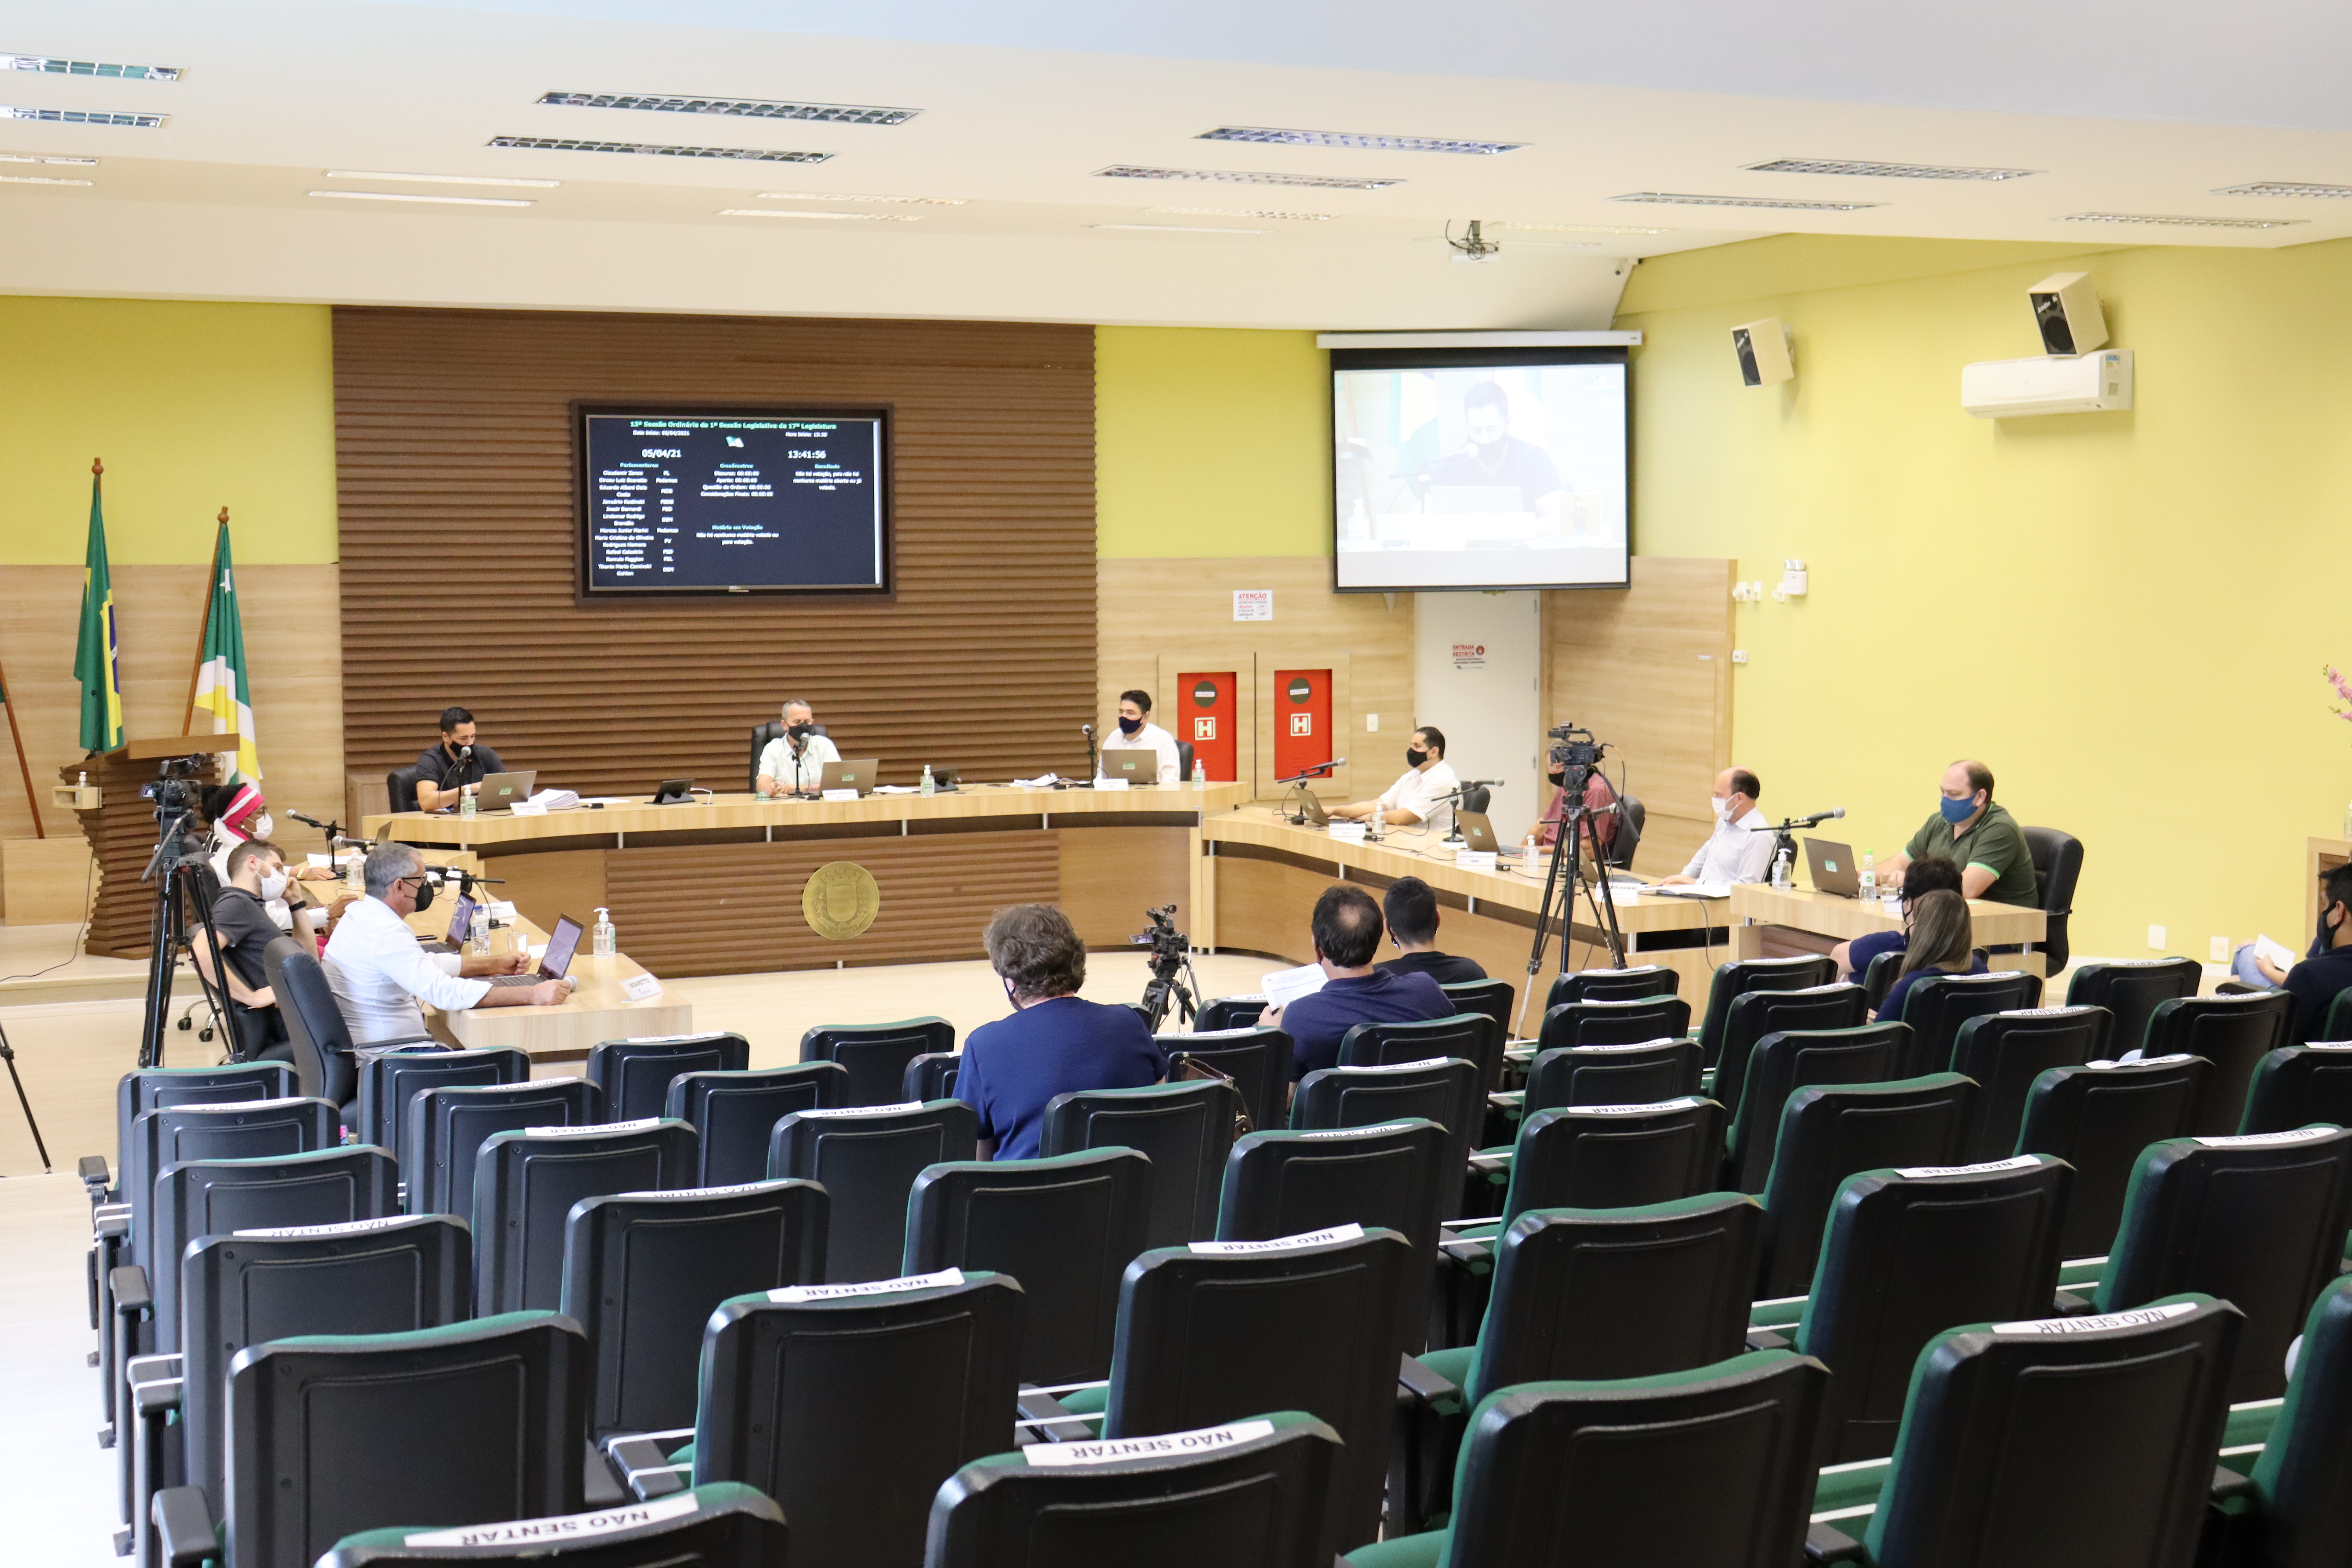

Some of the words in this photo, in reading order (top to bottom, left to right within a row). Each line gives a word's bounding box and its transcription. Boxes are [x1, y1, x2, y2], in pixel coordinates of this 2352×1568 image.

[642, 449, 681, 458] 05/04/21
[788, 450, 826, 459] 13:41:56
[1198, 721, 1212, 736] H
[1294, 717, 1307, 732] H
[272, 1225, 344, 1236] SENTAR
[1222, 1241, 1292, 1251] SENTAR
[1297, 1232, 1334, 1246] NÃO
[804, 1286, 882, 1296] SENTAR
[889, 1279, 929, 1290] NÃO
[2035, 1317, 2119, 1334] SENTAR
[1181, 1431, 1234, 1448] NÃO
[1070, 1439, 1172, 1458] SENTAR
[590, 1511, 649, 1528] NÃO
[460, 1521, 577, 1546] SENTAR
